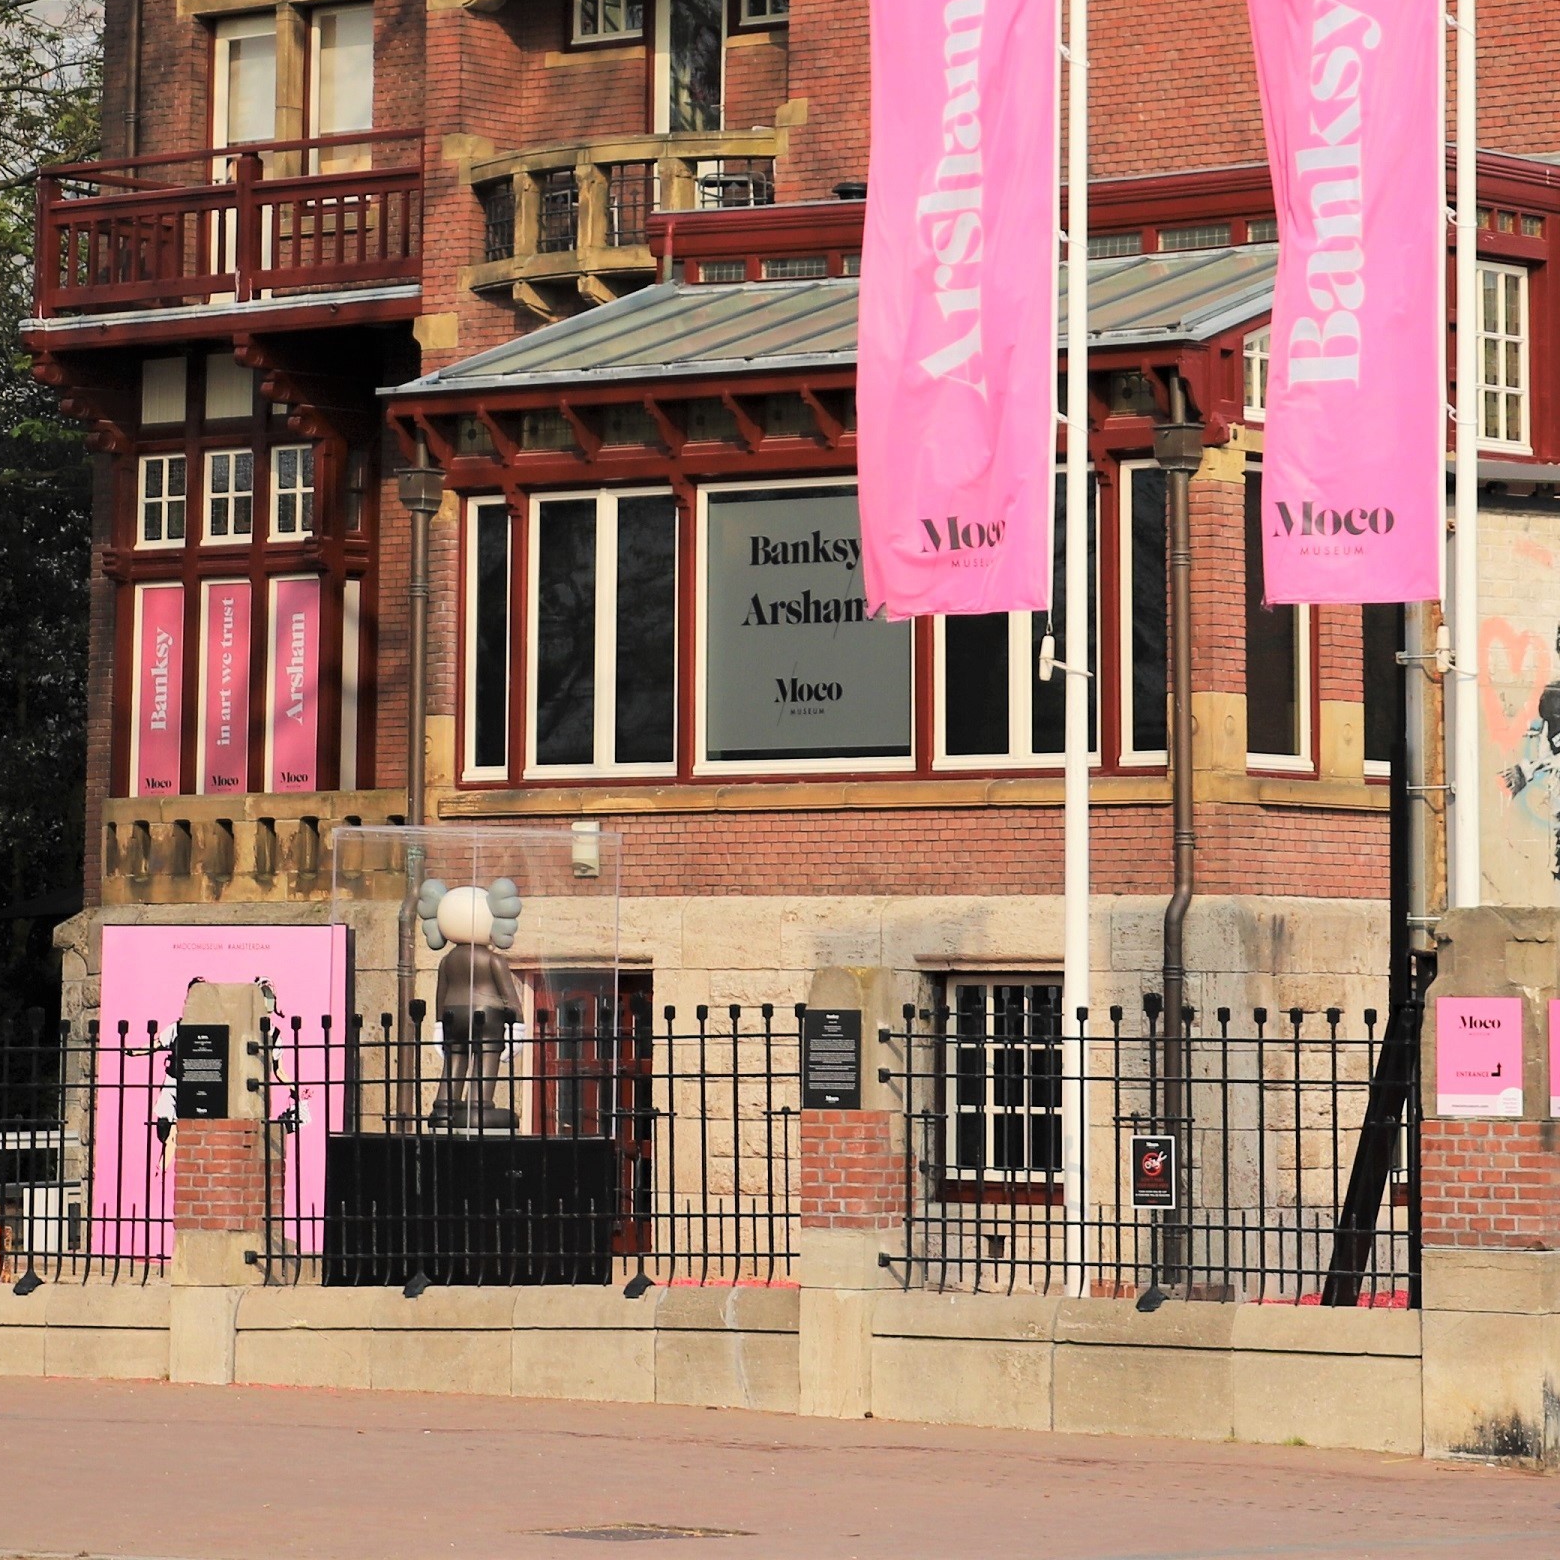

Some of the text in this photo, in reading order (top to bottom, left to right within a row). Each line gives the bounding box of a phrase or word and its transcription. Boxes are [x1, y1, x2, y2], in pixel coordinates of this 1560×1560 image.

[1271, 500, 1395, 537] Moco
[919, 516, 1006, 553] Moco
[749, 530, 862, 570] Banksy
[1300, 545, 1365, 556] MUSEUM
[151, 627, 173, 731] Banksy
[217, 597, 235, 746] in art we trust
[286, 612, 305, 726] Arsham
[774, 677, 843, 703] Moco
[145, 777, 172, 789] Moco
[212, 776, 239, 787] Moco
[280, 772, 308, 783] Moco
[173, 943, 271, 951] #MOCOMUSEUM #AMSTERDAM
[1459, 1016, 1501, 1029] Moco
